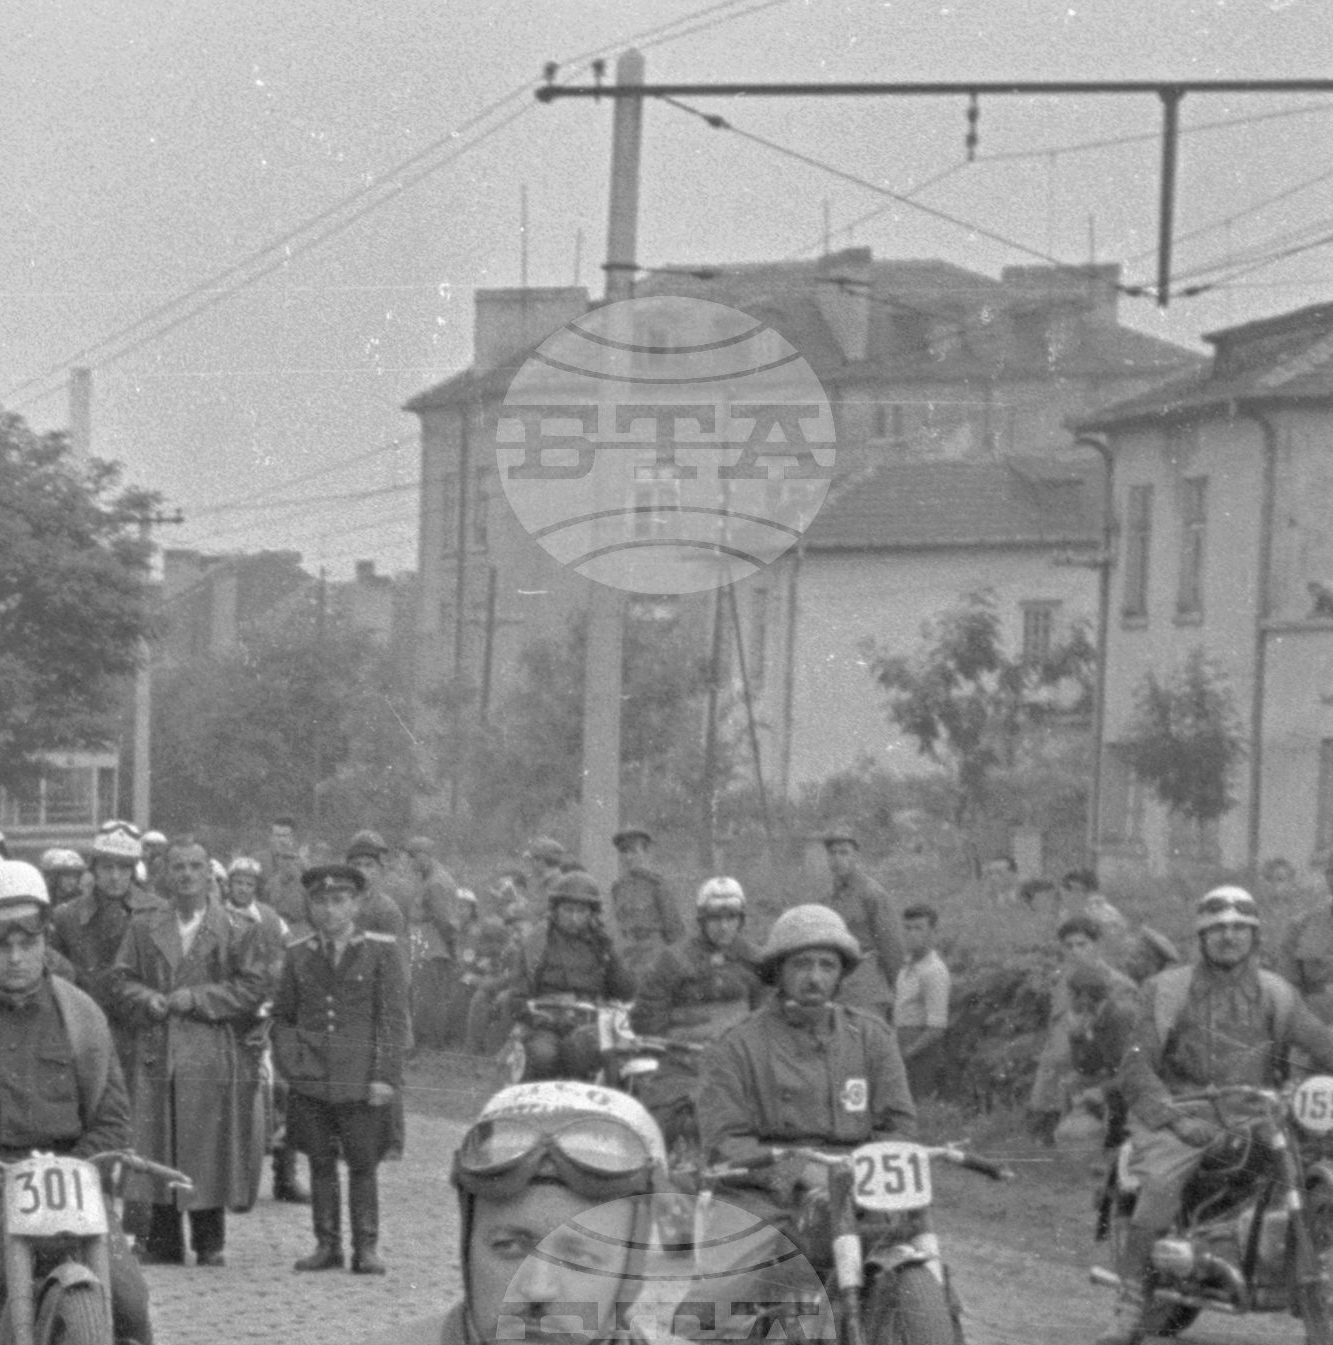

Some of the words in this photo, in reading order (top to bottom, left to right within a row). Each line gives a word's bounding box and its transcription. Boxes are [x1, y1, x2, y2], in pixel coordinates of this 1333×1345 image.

[1300, 1091, 1333, 1119] 15
[15, 1167, 84, 1215] 301
[854, 1152, 924, 1196] 251
